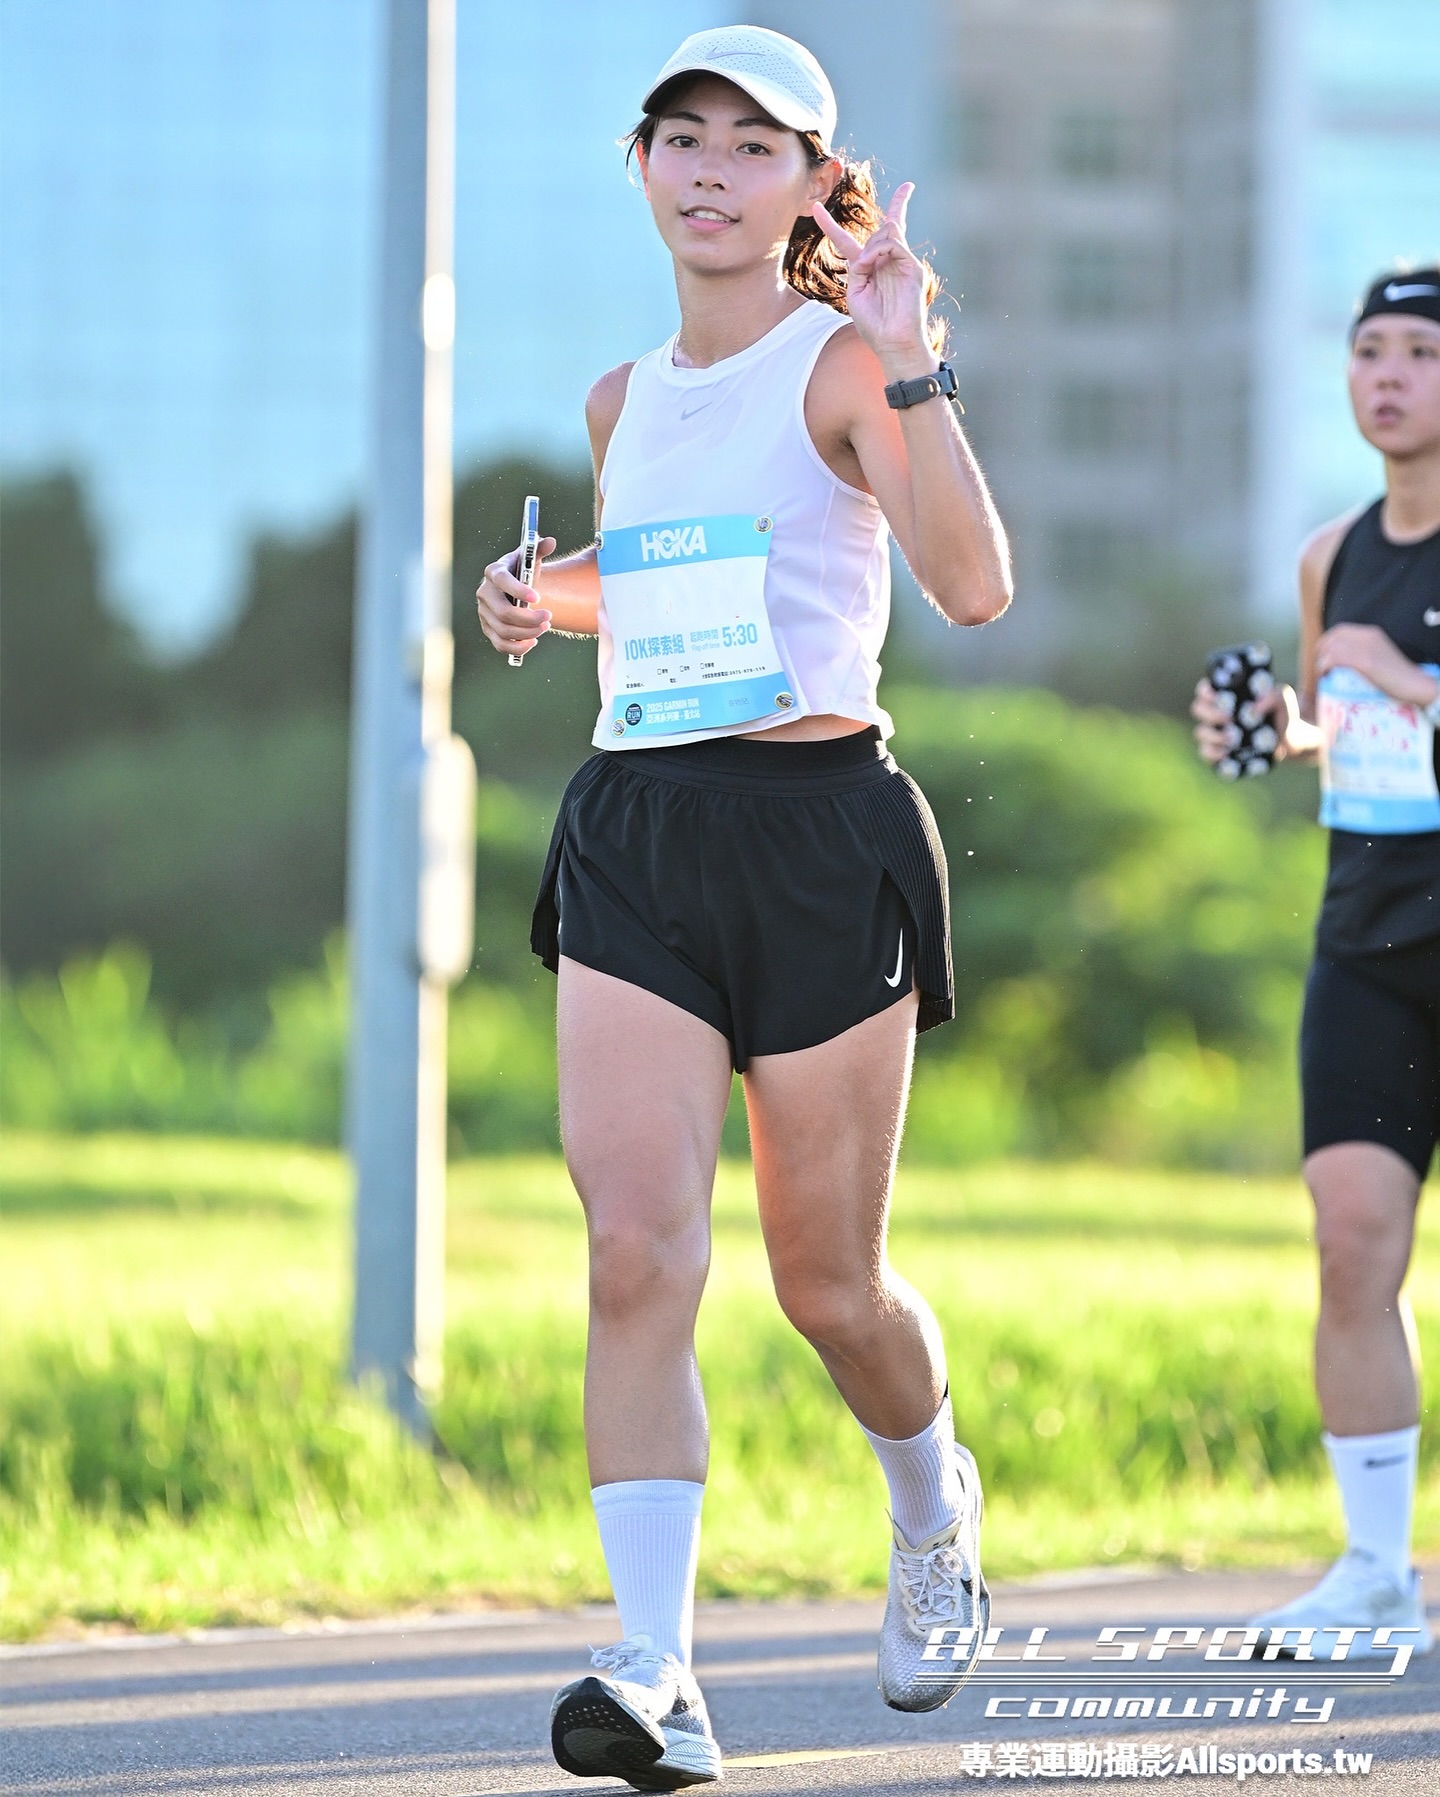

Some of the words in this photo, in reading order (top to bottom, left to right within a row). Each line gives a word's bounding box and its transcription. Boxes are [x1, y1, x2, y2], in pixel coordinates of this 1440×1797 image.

[640, 525, 707, 562] HOKA
[625, 634, 685, 661] 10K探索組
[722, 623, 758, 648] 5:30
[646, 702, 664, 713] 2025
[664, 699, 687, 710] GARMIN
